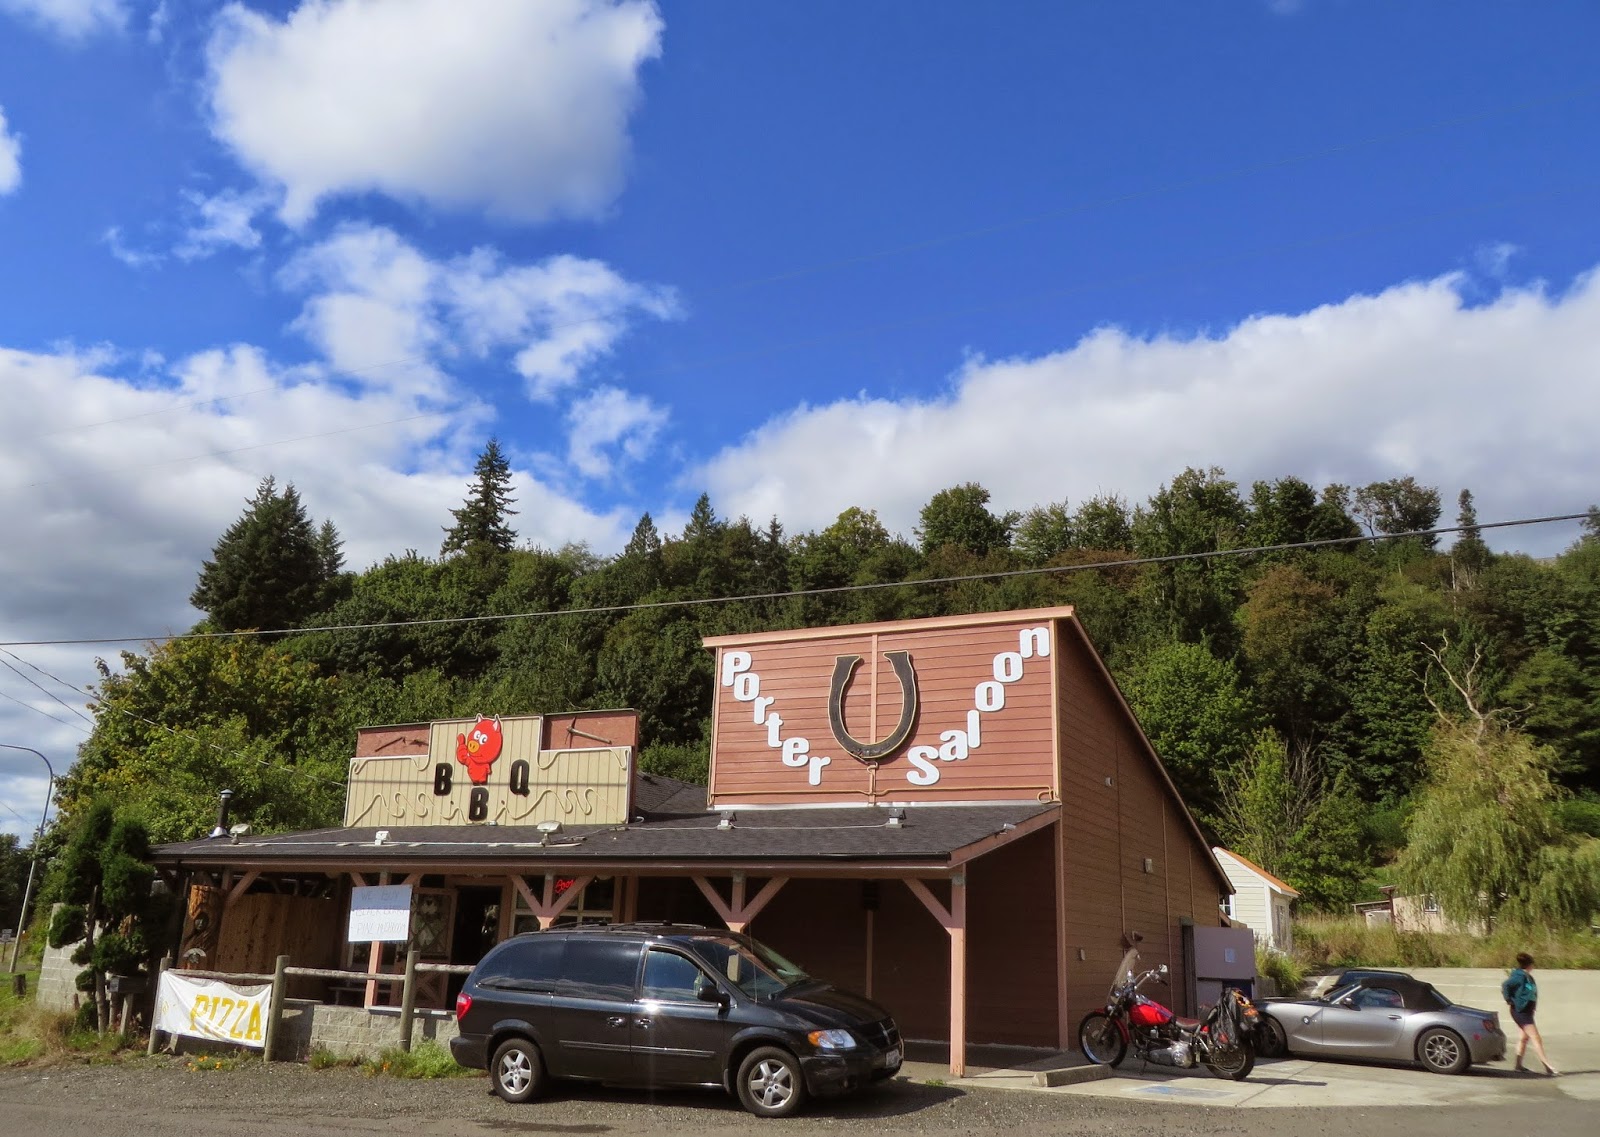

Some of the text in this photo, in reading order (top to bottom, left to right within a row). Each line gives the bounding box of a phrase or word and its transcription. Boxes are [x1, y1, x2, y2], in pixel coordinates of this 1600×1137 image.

[722, 626, 1050, 786] Porter Saloon
[189, 994, 262, 1041] PIZZA
